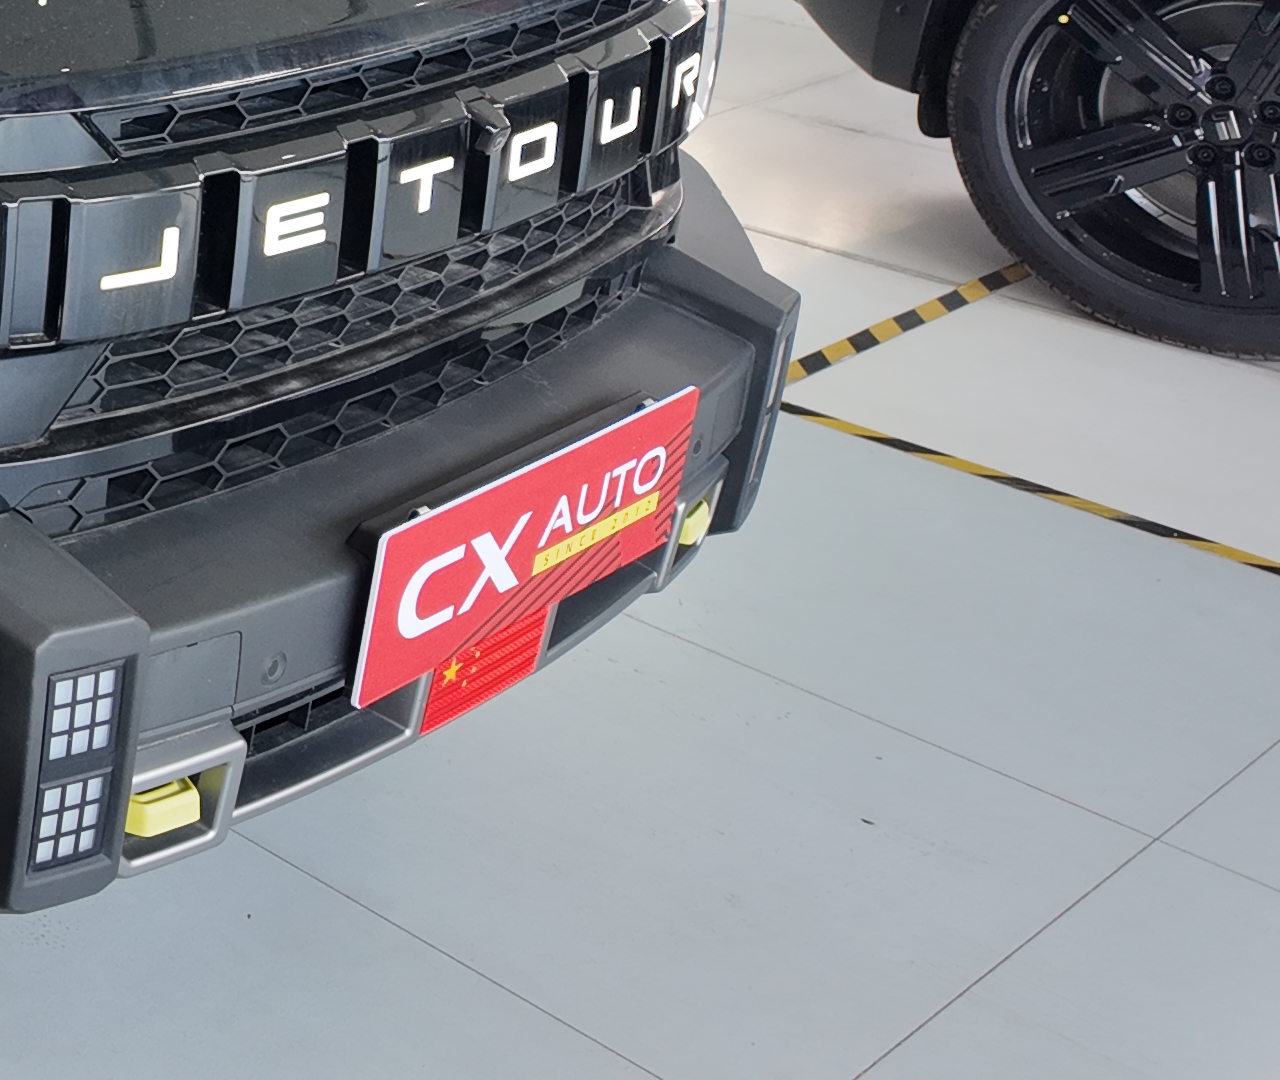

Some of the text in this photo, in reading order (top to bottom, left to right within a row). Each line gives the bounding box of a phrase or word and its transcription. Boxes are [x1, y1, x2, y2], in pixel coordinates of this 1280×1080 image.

[99, 51, 701, 291] JETOUR
[396, 445, 667, 639] CX AUTO
[542, 498, 654, 568] SINCE 2012
